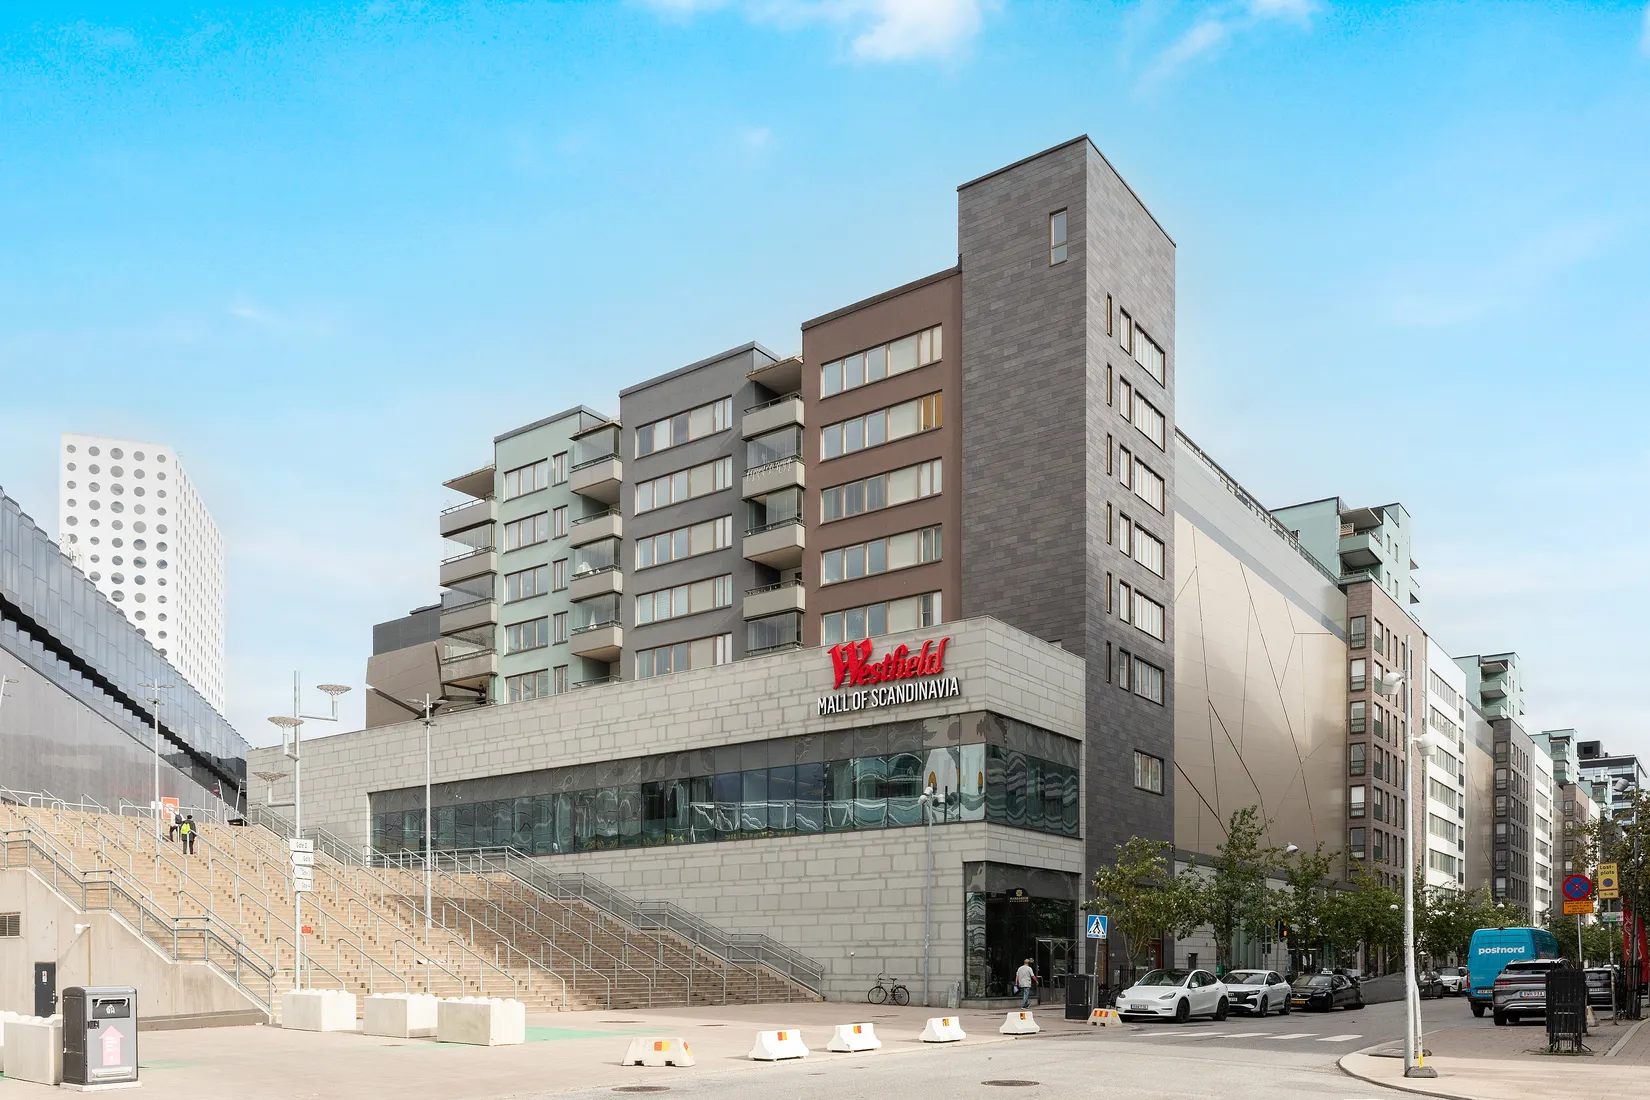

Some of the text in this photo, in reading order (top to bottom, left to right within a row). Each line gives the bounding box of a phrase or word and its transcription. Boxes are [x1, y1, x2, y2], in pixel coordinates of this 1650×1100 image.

[827, 637, 951, 690] Westfield
[817, 676, 961, 715] MALL OF SCANDINAVIA
[1478, 946, 1525, 955] postnord
